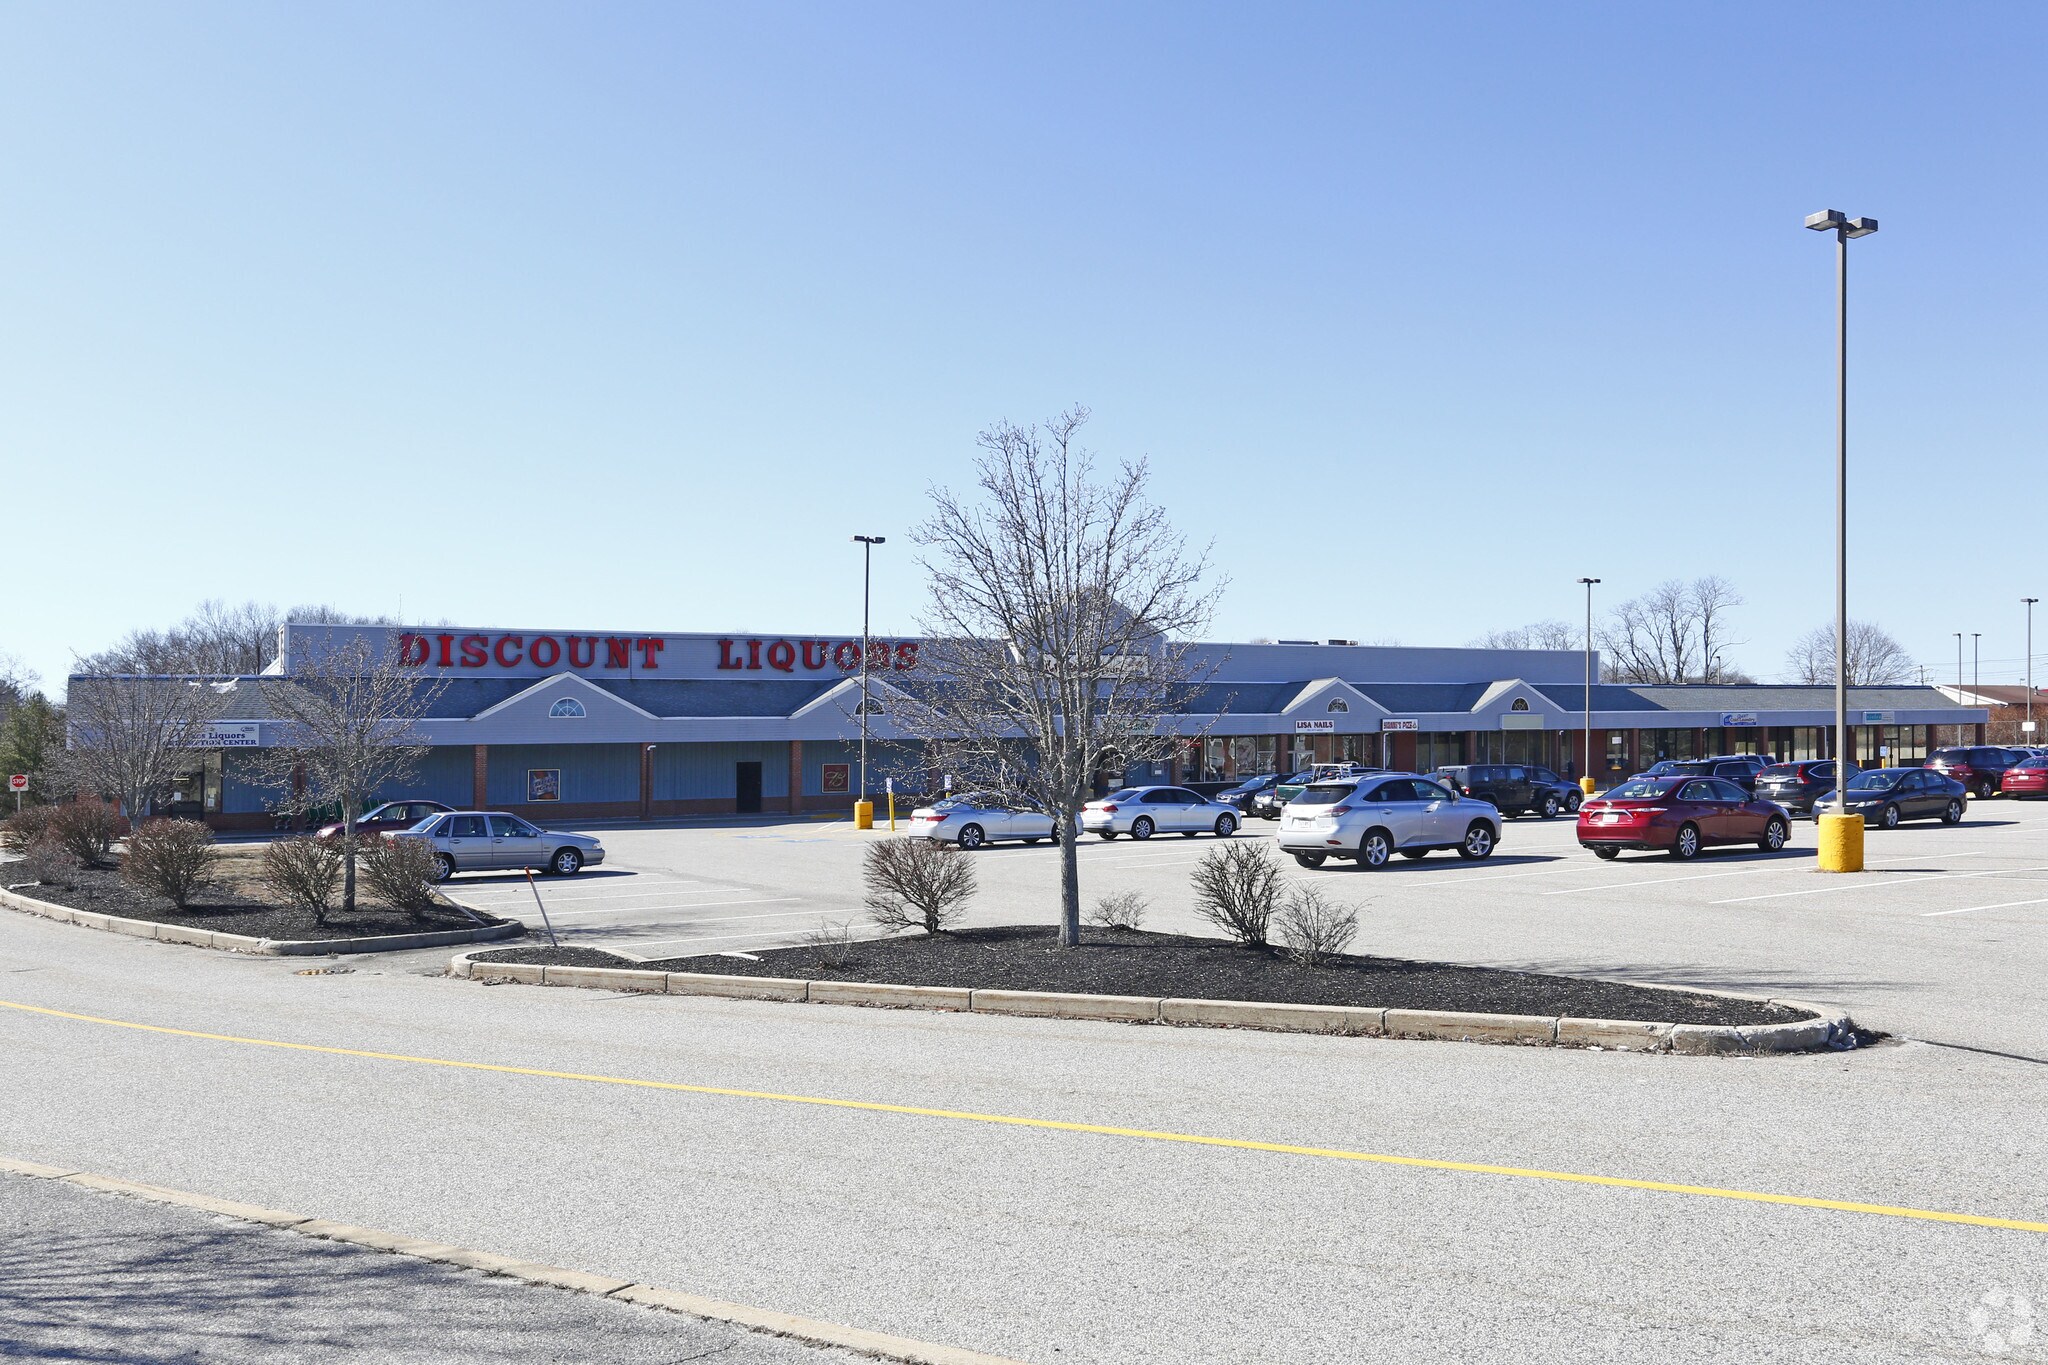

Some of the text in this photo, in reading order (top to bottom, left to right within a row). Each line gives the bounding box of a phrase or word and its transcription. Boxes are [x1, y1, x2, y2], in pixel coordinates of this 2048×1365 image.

[399, 634, 919, 673] DISCOUNT LIQUORS
[1297, 721, 1333, 729] LISA NAILS
[209, 732, 245, 740] Liquors
